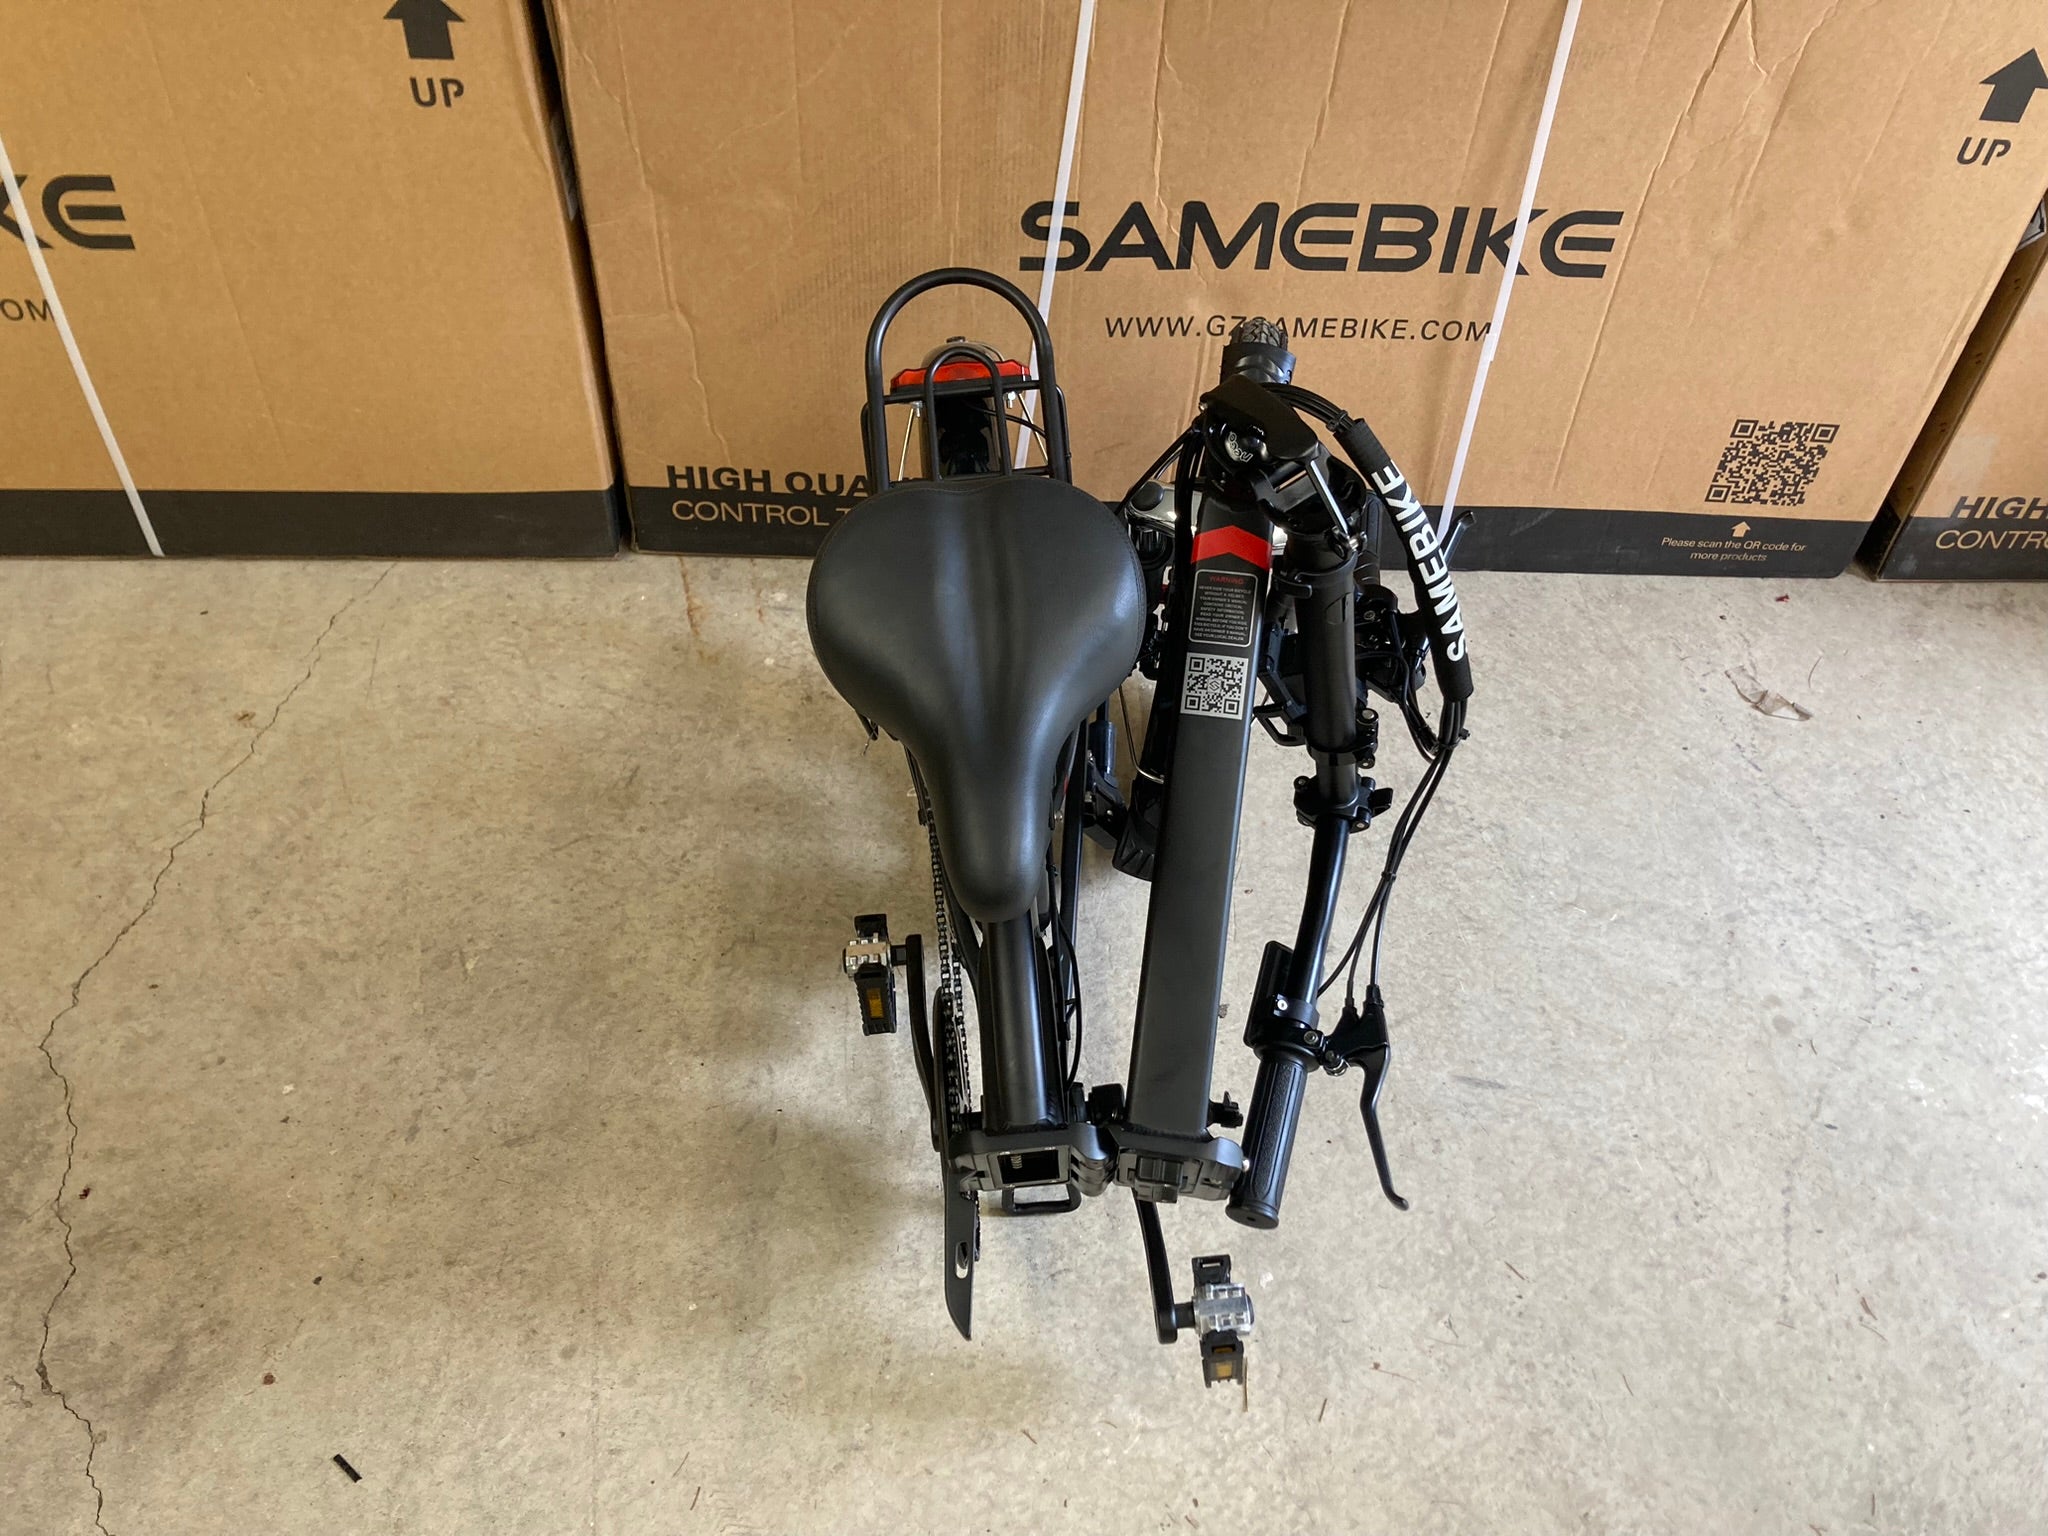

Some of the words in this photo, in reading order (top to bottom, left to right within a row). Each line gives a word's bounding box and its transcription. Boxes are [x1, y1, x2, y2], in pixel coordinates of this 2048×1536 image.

[410, 77, 465, 108] UP
[1956, 137, 2012, 166] UP
[1019, 200, 1625, 279] SAMEBIKE
[1105, 316, 1492, 342] WWW.GZAMEBIKE.COM
[667, 465, 771, 493] HIGH
[671, 500, 829, 526] CONTROL
[1661, 537, 1696, 548] Please
[1697, 540, 1722, 549] scan
[1724, 539, 1741, 549] the
[1743, 540, 1760, 550] QR
[1762, 541, 1789, 551] code
[1790, 542, 1807, 552] for
[1936, 530, 2048, 549] CONTR
[1371, 459, 1468, 662] SAMEBIKE
[1689, 552, 1719, 561] more
[1720, 553, 1768, 562] products
